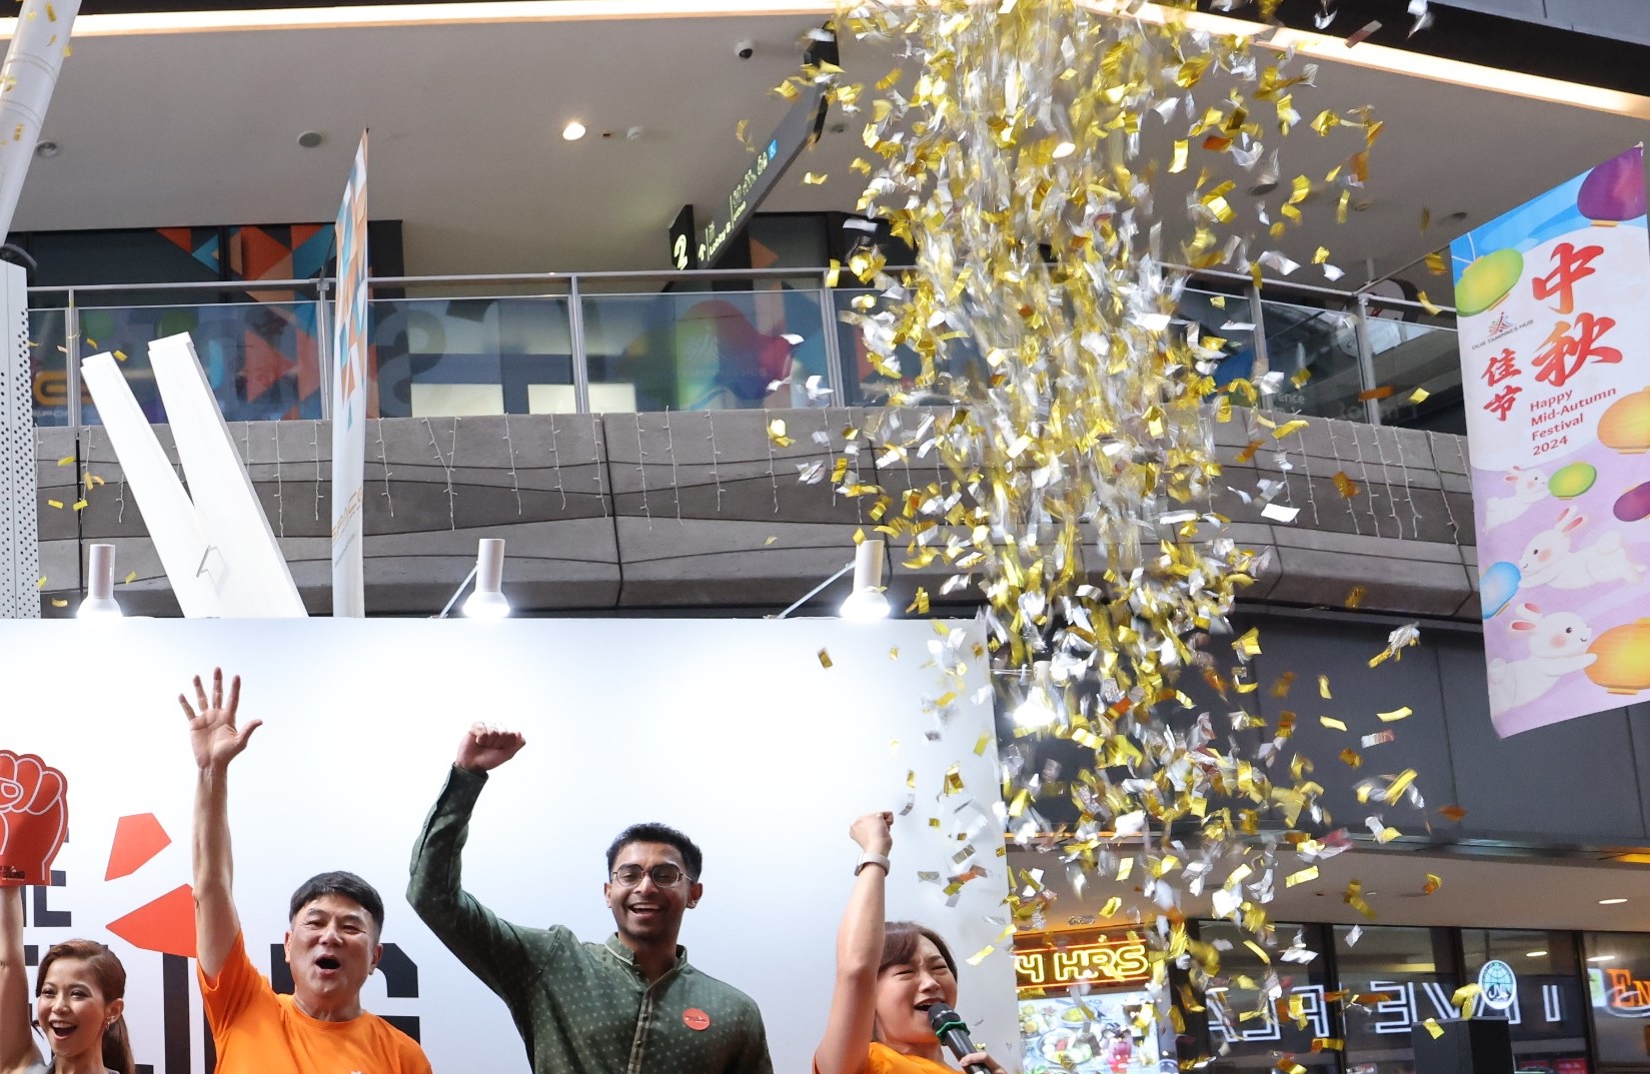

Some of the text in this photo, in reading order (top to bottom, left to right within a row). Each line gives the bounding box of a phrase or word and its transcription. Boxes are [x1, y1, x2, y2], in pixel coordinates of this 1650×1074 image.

[674, 234, 688, 271] 2
[1531, 242, 1623, 387] 中秋
[1480, 347, 1523, 422] 佳节
[1530, 389, 1573, 412] Happy
[1530, 387, 1617, 427] Mid-Autumn
[1531, 413, 1584, 442] Festival
[1532, 434, 1569, 456] 2024
[1054, 945, 1150, 983] HRS
